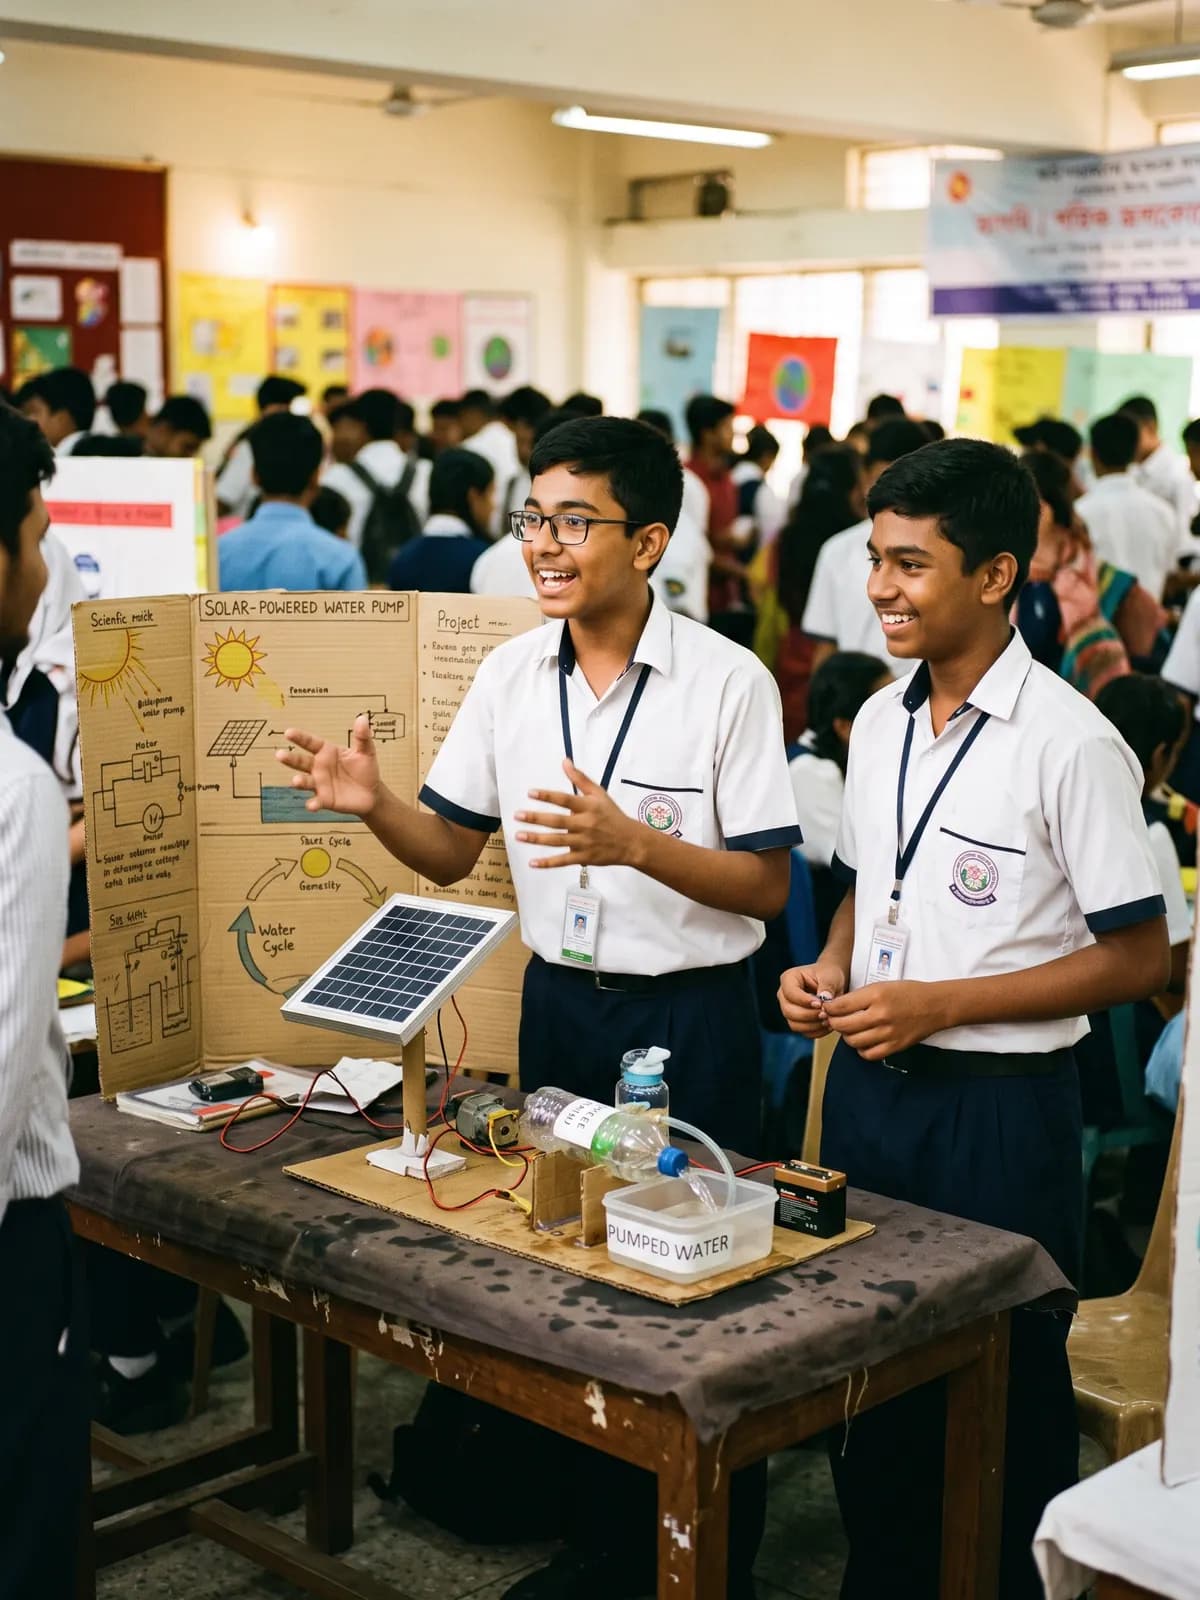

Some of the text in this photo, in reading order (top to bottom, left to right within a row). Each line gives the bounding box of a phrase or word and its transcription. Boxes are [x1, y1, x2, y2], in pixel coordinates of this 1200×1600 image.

[205, 599, 404, 616] SOLAR-POWERED WATER PUMP
[438, 610, 480, 634] Project
[329, 836, 351, 847] Cycle
[259, 923, 296, 936] Water
[262, 939, 295, 958] Cycle
[608, 1224, 728, 1261] PUMPED WATER
